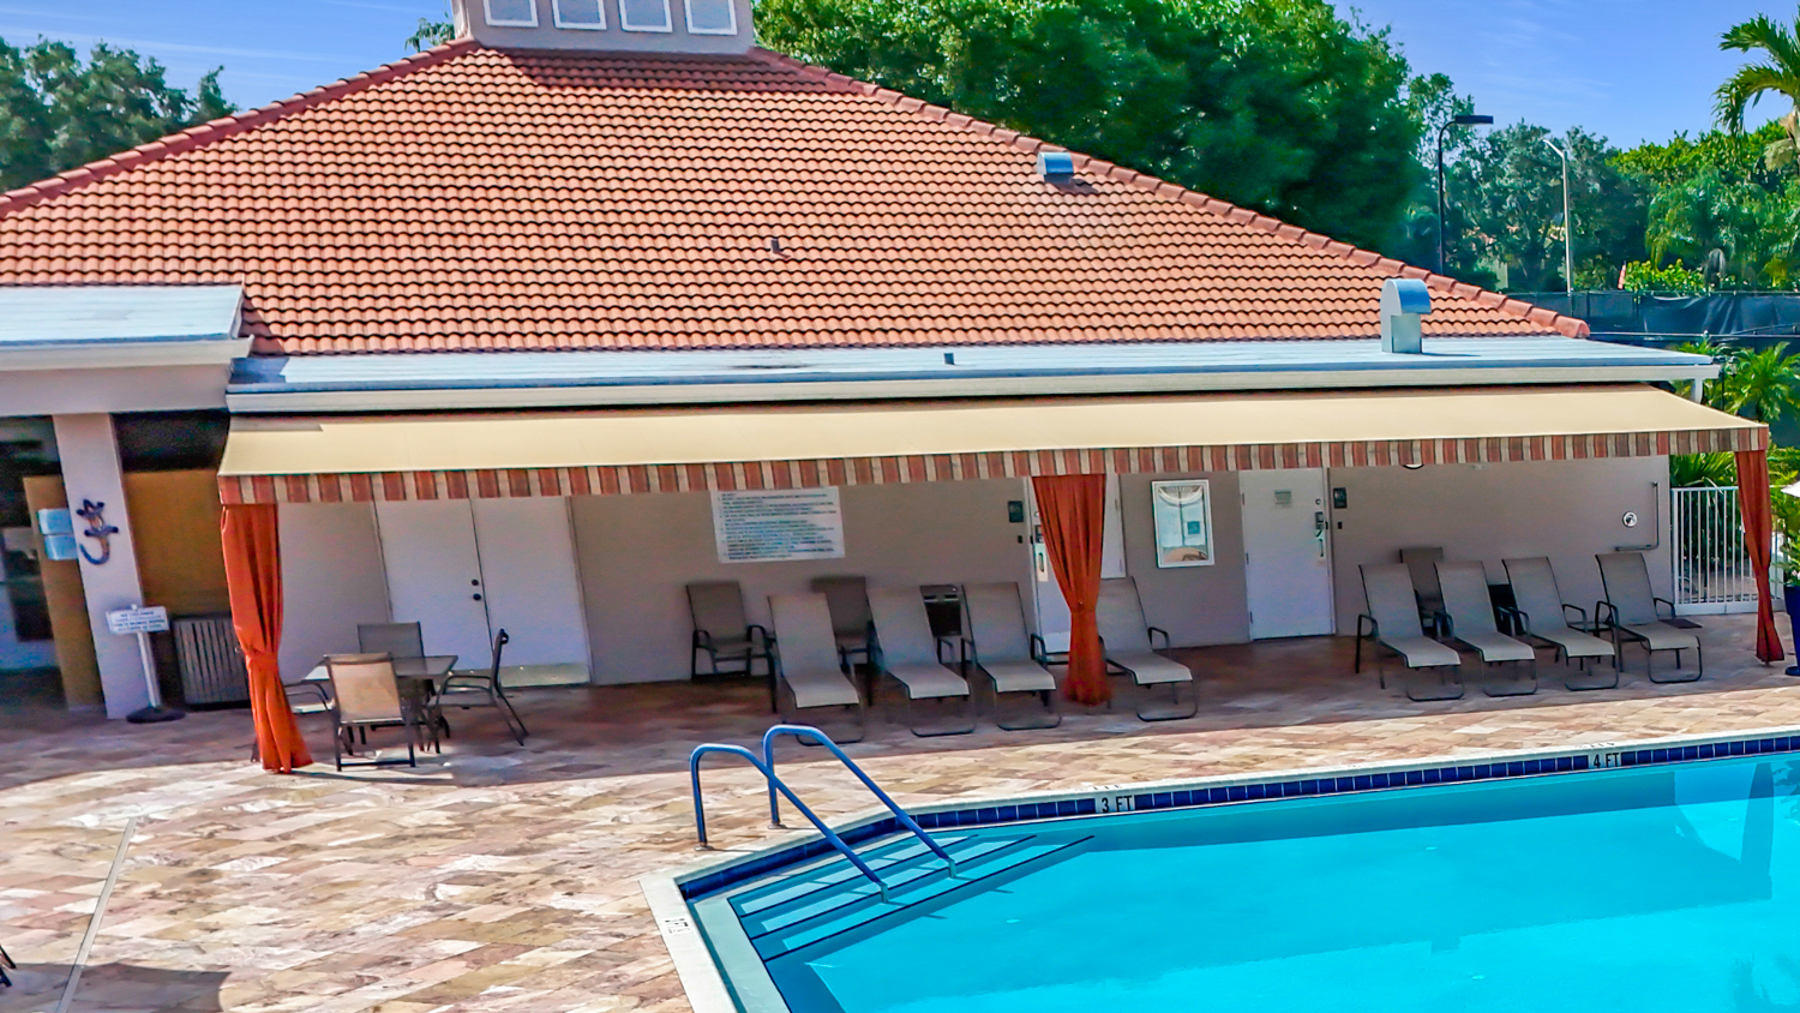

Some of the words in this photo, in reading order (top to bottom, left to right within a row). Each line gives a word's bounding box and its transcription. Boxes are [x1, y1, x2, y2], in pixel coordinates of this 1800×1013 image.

[1593, 754, 1601, 768] 4
[1605, 752, 1620, 768] FT
[1101, 797, 1110, 813] 3
[1115, 795, 1133, 812] FT
